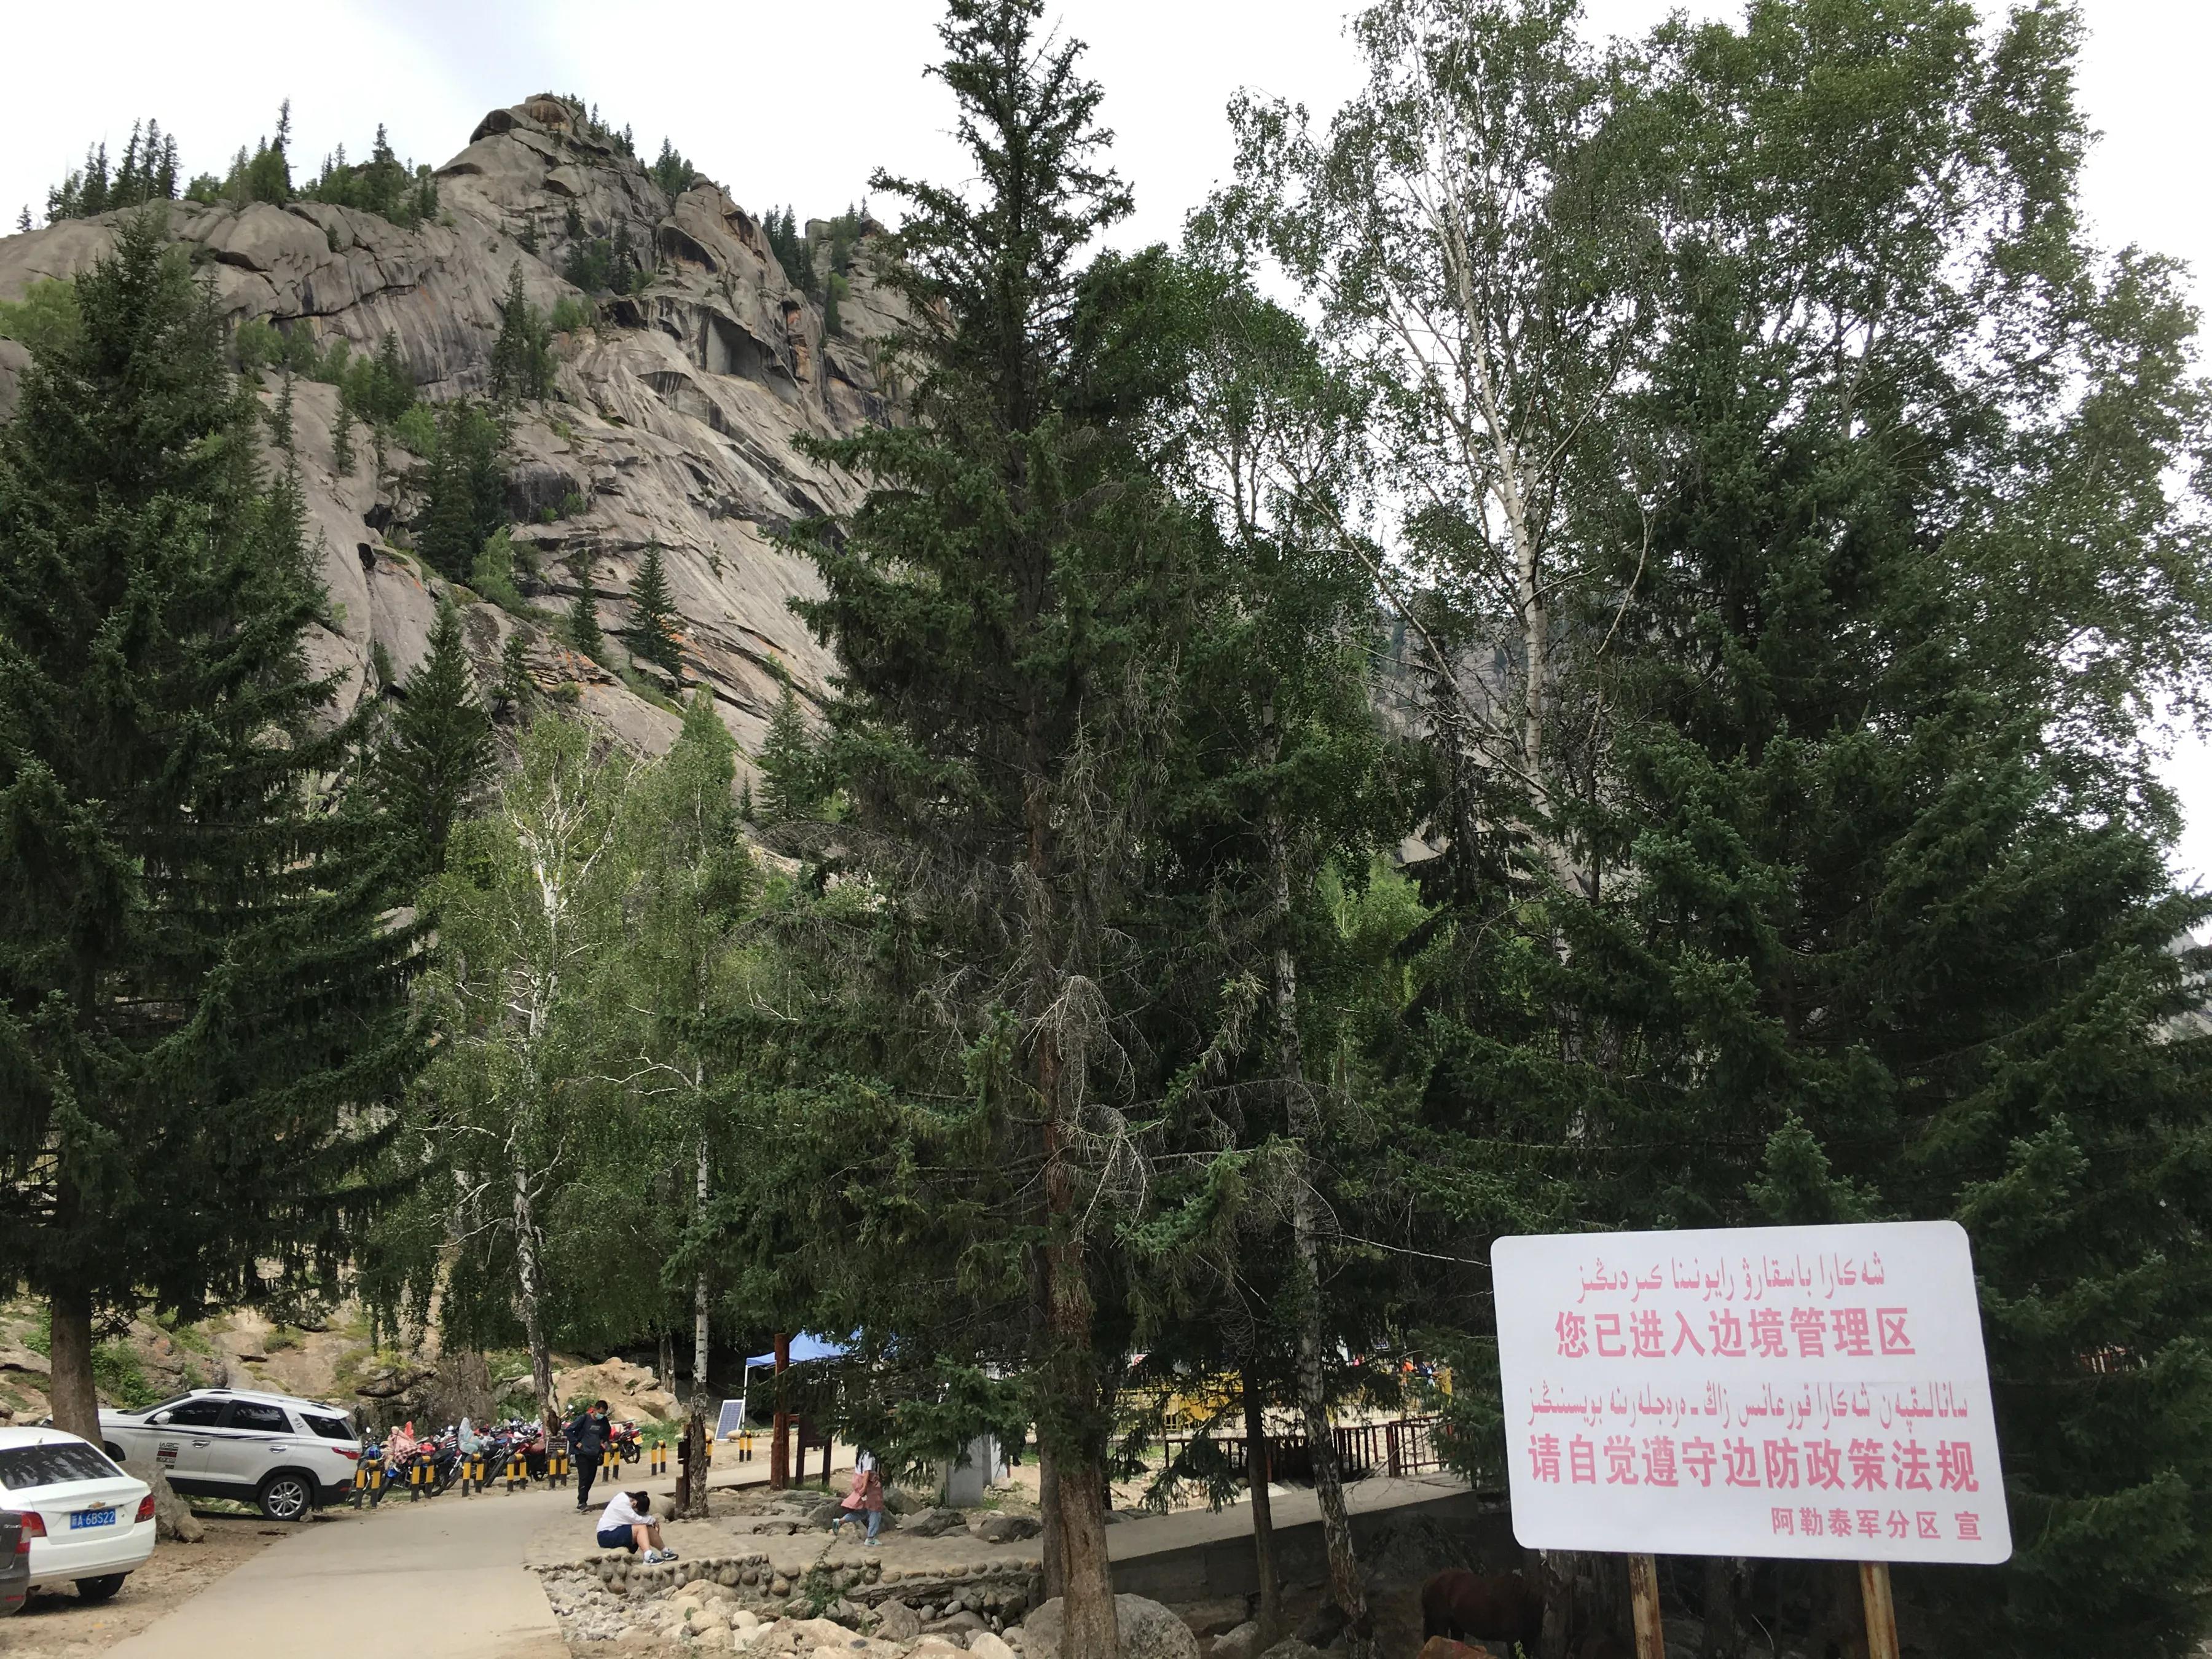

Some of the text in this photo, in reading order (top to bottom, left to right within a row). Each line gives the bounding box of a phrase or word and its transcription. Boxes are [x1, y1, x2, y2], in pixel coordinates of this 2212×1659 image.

[1555, 1306, 1916, 1359] 您已进入边境管理区
[1528, 1433, 1979, 1493] 请自觉遵守边防政策法规
[1771, 1507, 1982, 1542] 阿勒泰军分区 宣
